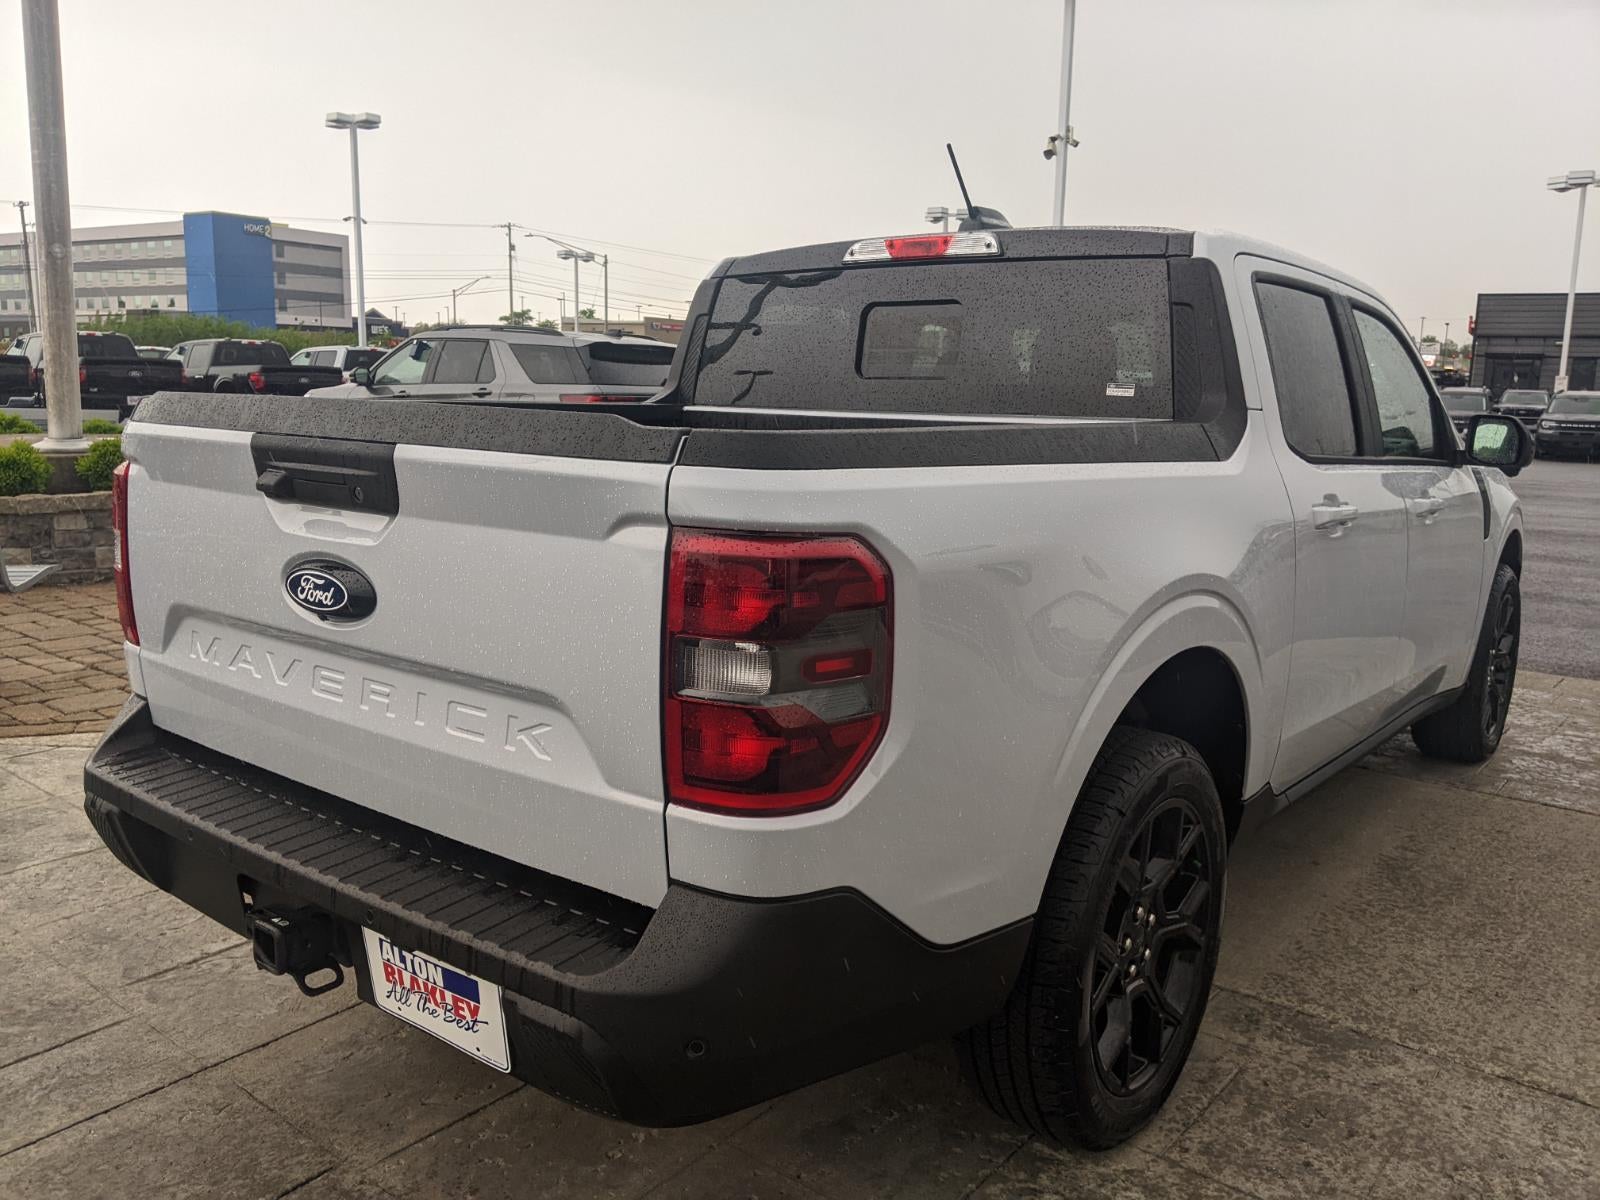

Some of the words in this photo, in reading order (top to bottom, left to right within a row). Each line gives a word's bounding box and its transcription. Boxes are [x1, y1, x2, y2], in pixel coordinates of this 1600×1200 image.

[297, 575, 335, 606] Ford
[189, 630, 553, 762] MAVERICK
[382, 941, 444, 988] ALTON
[386, 980, 412, 1007] All
[412, 990, 441, 1019] The
[439, 1002, 489, 1034] Best
